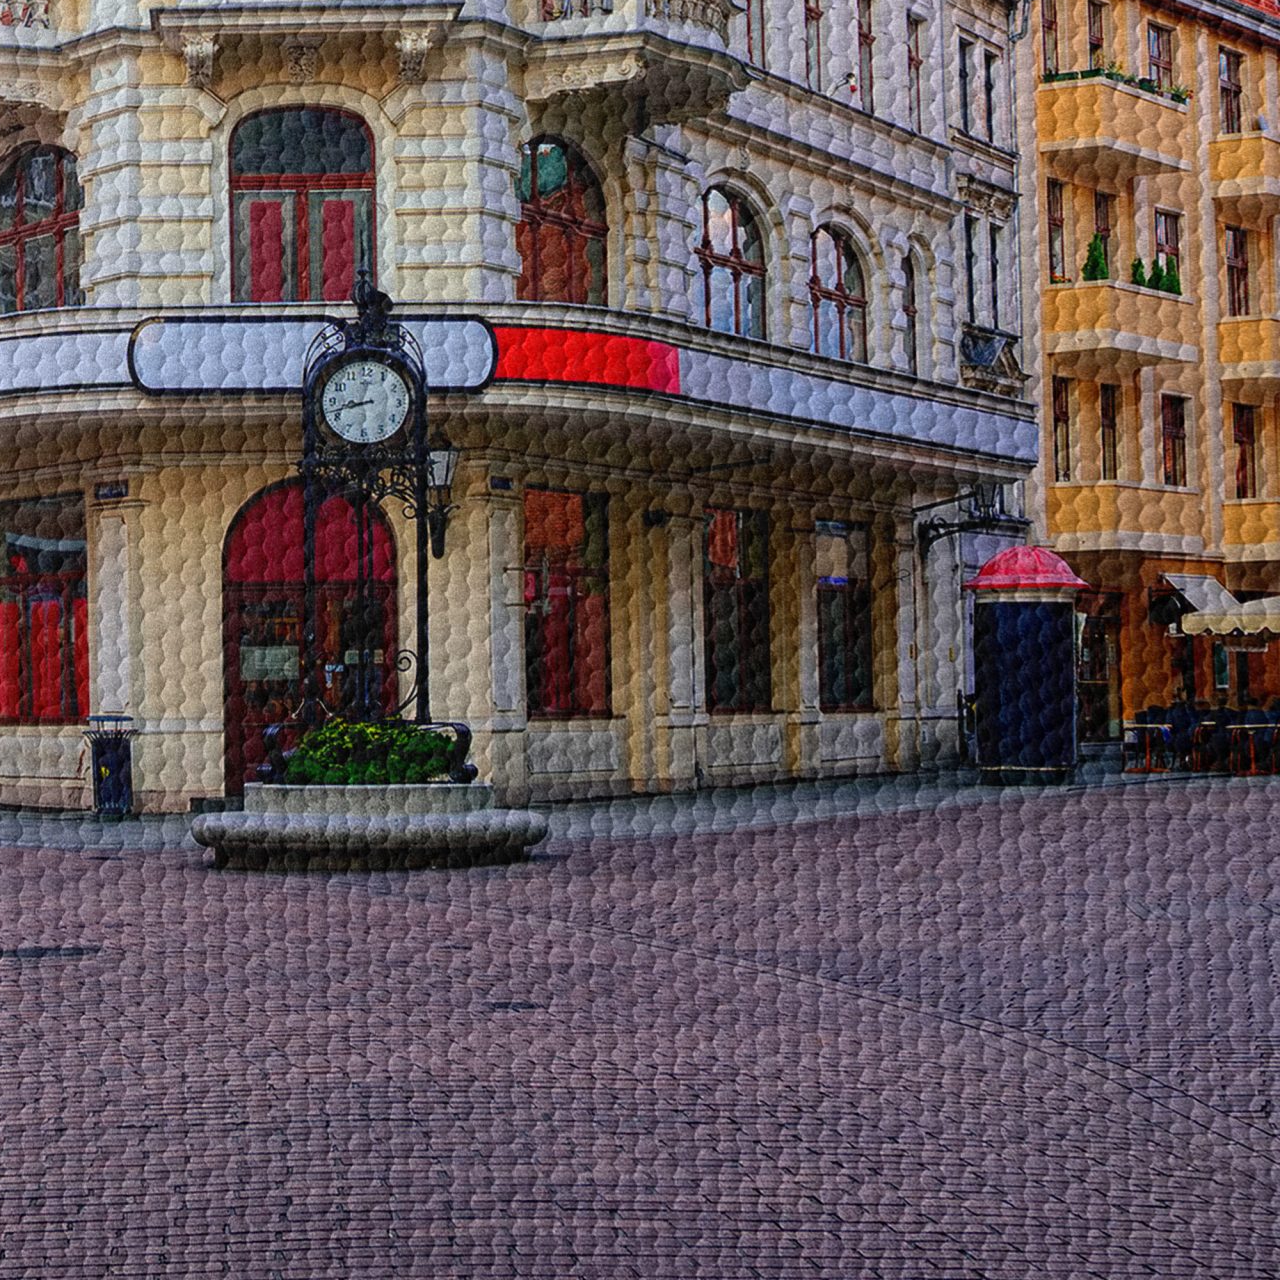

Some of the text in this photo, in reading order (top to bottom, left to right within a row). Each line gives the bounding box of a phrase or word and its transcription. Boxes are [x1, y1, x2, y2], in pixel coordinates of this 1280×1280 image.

[346, 371, 356, 381] 11
[362, 366, 373, 377] 12
[380, 371, 386, 381] 1
[334, 382, 346, 392] 10
[390, 383, 397, 393] 2
[329, 396, 336, 407] 9
[395, 398, 402, 408] 3
[334, 412, 341, 422] 8
[388, 414, 396, 423] 4
[346, 423, 352, 433] 7
[360, 427, 368, 437] 6
[378, 424, 384, 434] 5
